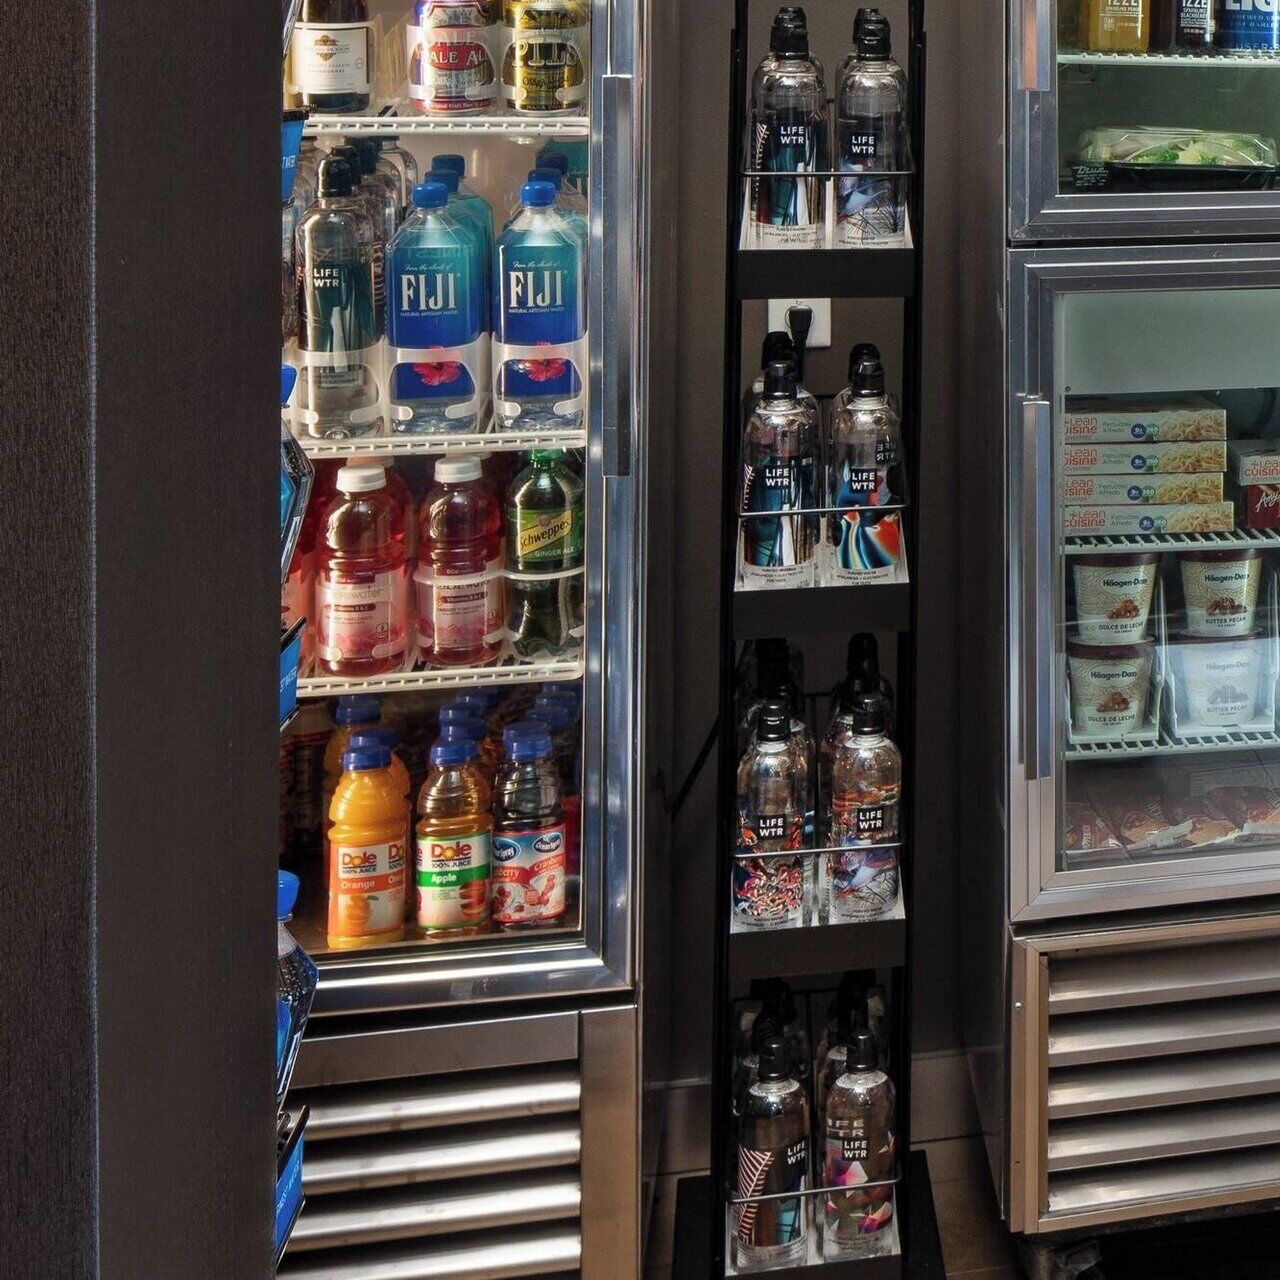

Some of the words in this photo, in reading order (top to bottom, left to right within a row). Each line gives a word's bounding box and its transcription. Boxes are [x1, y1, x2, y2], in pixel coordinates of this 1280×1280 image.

[781, 126, 804, 135] LIFE
[781, 135, 804, 144] WTR
[852, 135, 875, 144] LIFE
[852, 145, 875, 154] WTR
[314, 269, 339, 277] LIFE
[313, 279, 340, 287] WTR
[400, 273, 456, 311] FIJI
[509, 270, 563, 308] FIJI
[766, 468, 789, 477] LIFE
[852, 472, 875, 481] LIFE
[766, 478, 790, 487] WTR
[852, 481, 875, 490] WTR
[535, 549, 558, 558] GINGER
[1099, 622, 1118, 631] DULCE
[1117, 714, 1135, 722] LECHE
[859, 811, 883, 820] LIFE
[759, 818, 783, 827] LIFE
[859, 820, 883, 829] WTR
[759, 828, 783, 837] WTR
[431, 841, 472, 860] Dole
[342, 852, 377, 867] Dole
[431, 861, 451, 869] 100%
[451, 859, 472, 868] JUICE
[358, 866, 377, 874] JUICE
[431, 873, 457, 886] Apple
[340, 879, 376, 890] Orange
[787, 1141, 806, 1156] LIFE
[844, 1140, 867, 1150] LIFE
[787, 1151, 806, 1165] WTR
[844, 1150, 867, 1159] WTR
